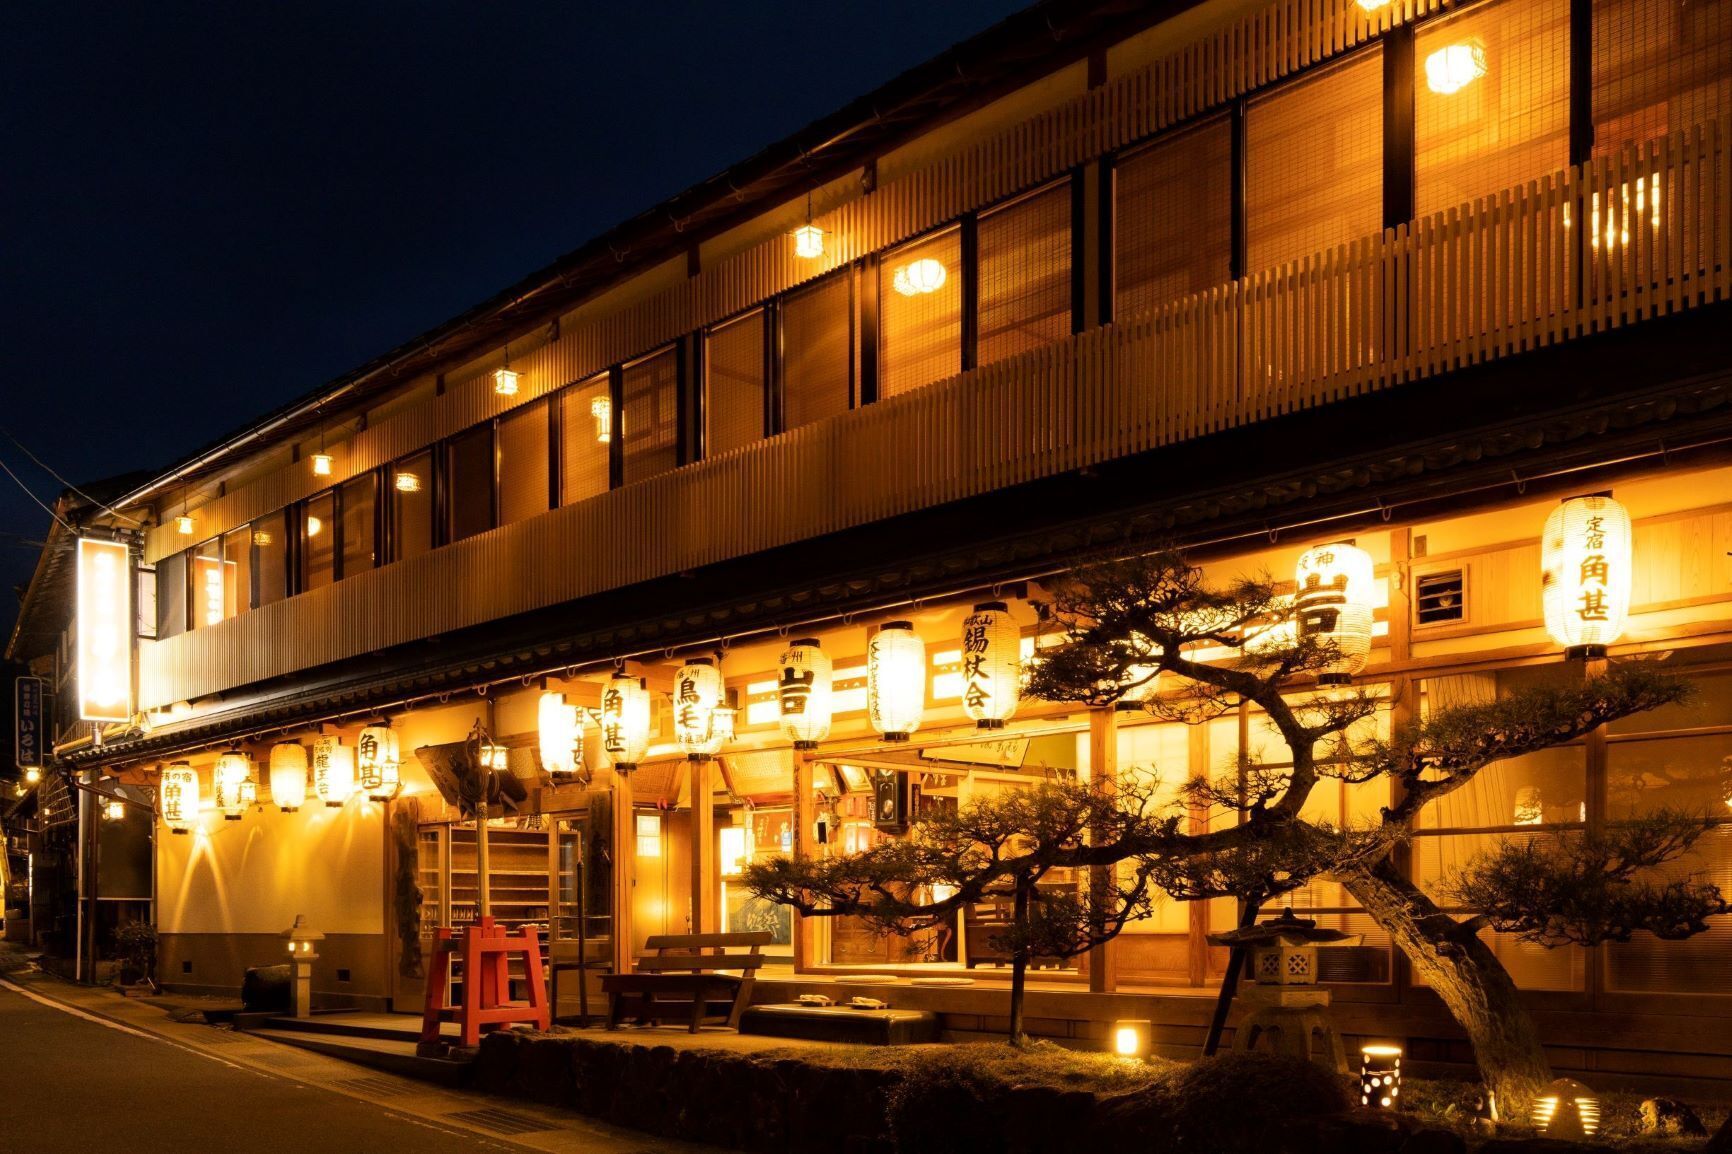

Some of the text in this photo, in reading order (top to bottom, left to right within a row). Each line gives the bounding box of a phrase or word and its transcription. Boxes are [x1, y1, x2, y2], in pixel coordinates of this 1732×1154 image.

[1585, 516, 1607, 550] 定宿
[1576, 554, 1609, 621] 角甚
[604, 689, 626, 752] 角甚
[676, 676, 701, 729] 鳥毛
[360, 733, 383, 790] 角甚
